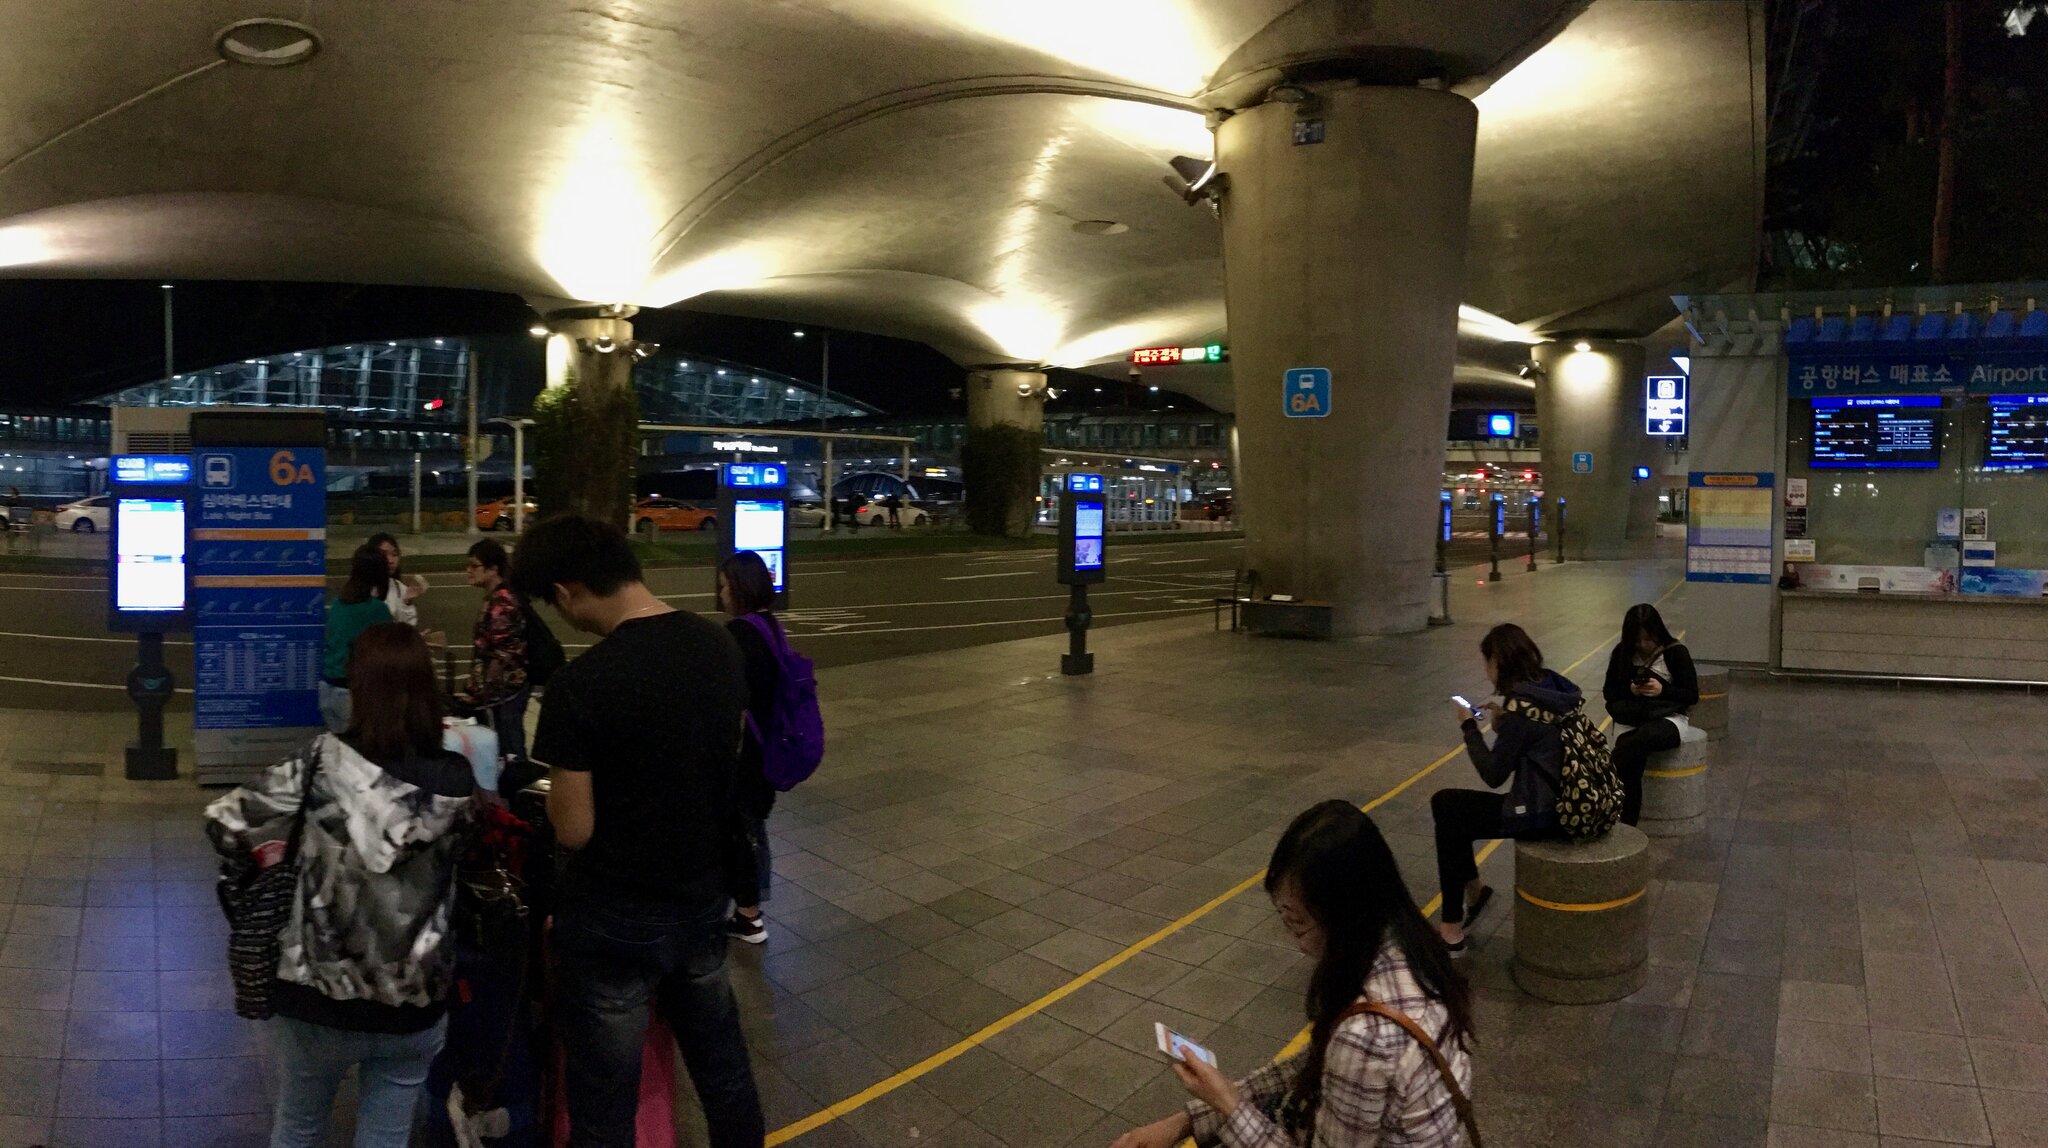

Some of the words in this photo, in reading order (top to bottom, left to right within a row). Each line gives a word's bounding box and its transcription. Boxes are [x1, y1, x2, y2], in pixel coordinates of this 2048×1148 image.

[1799, 366, 1881, 390] 공항버스
[1890, 364, 1953, 383] 매표소
[1970, 364, 2047, 386] Airport
[1290, 393, 1320, 412] 6A
[268, 450, 316, 486] 6A
